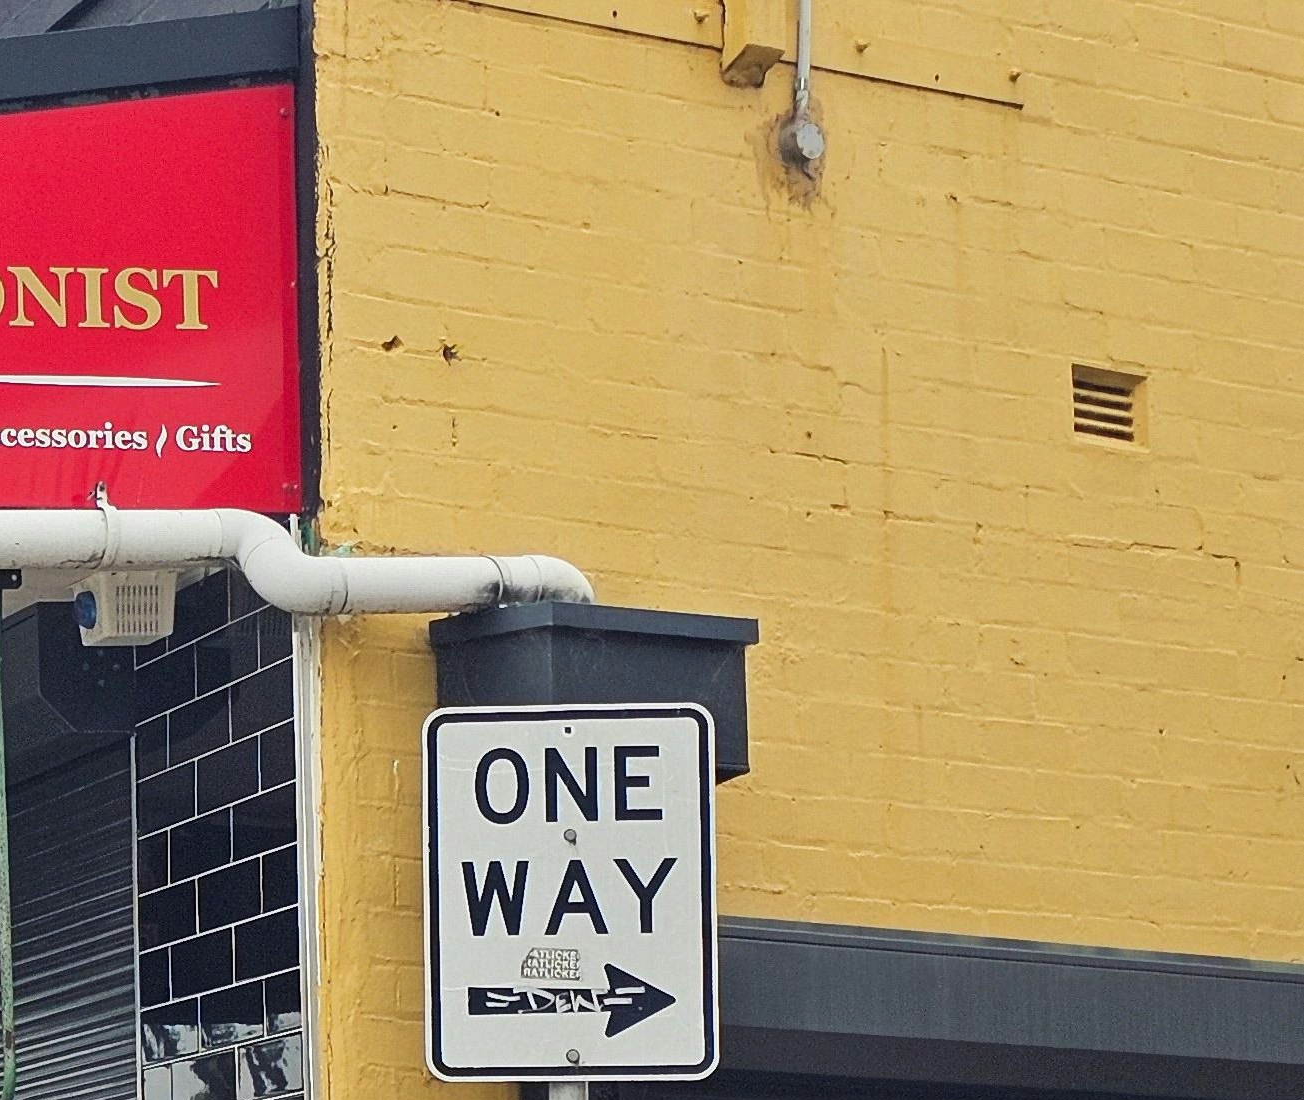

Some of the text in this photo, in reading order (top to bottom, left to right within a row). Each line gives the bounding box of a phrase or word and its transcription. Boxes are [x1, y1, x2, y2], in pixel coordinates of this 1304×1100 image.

[175, 425, 252, 454] Gifts
[474, 745, 663, 825] ONE
[461, 857, 678, 937] WAY
[529, 949, 581, 960] ATLICKE
